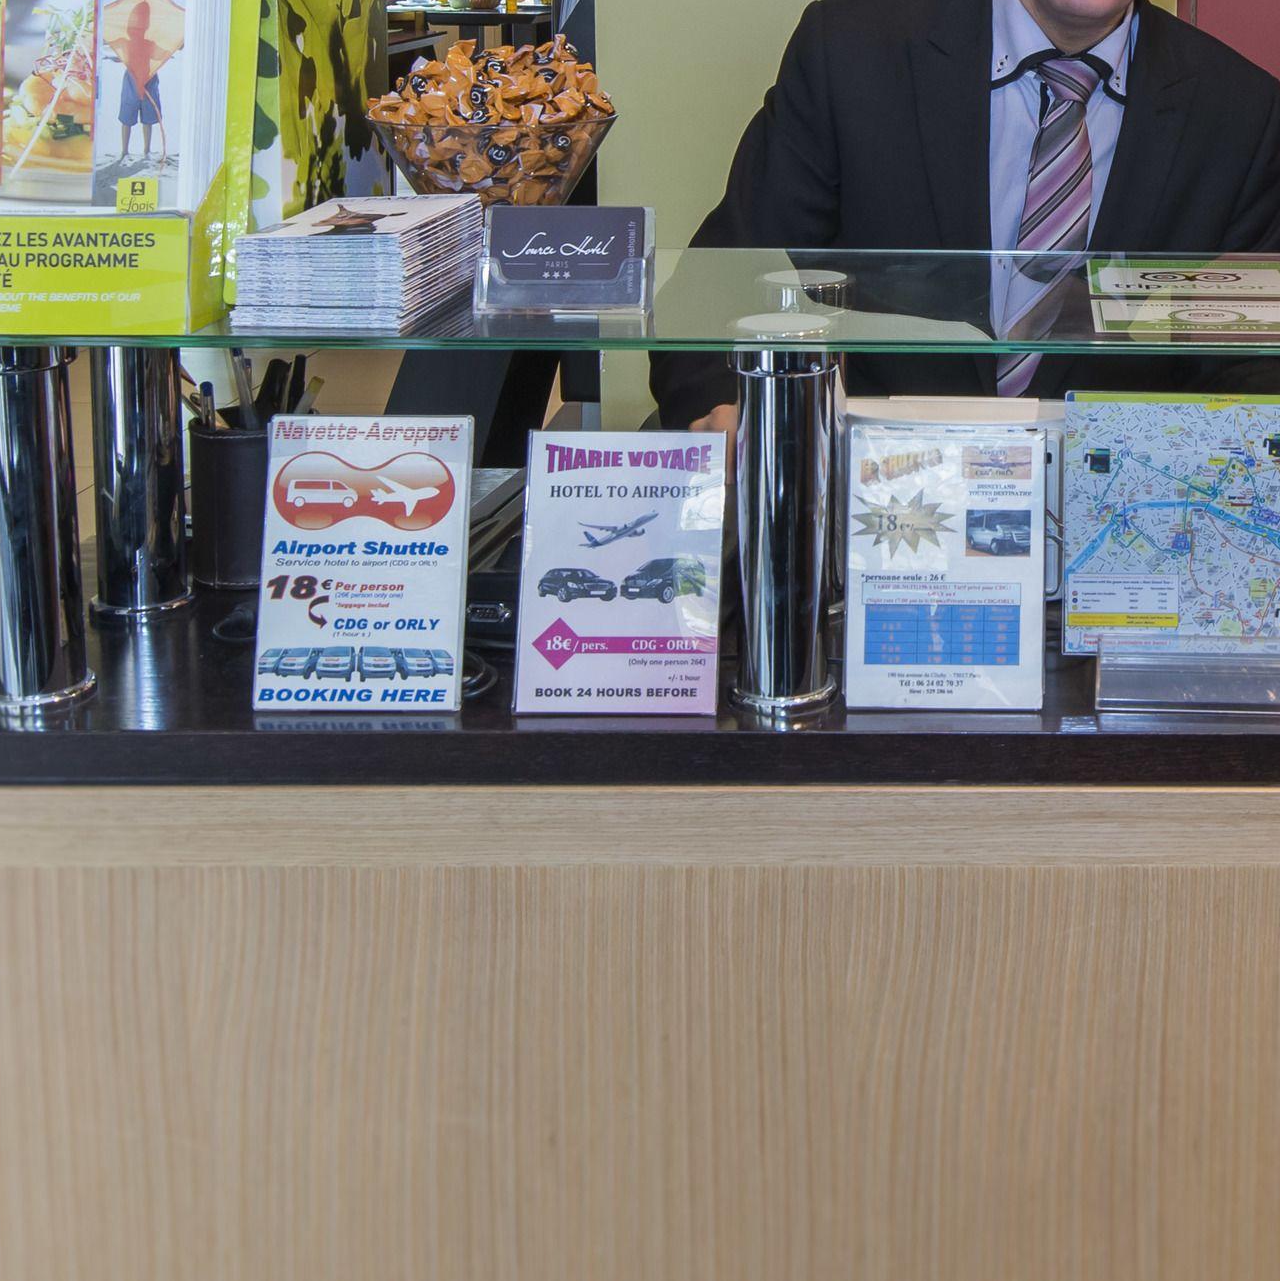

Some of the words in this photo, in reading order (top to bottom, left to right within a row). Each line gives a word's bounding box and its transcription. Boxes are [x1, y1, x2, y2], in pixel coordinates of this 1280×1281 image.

[16, 232, 48, 247] LES
[52, 232, 156, 248] AVANTAGES
[502, 231, 557, 258] Source
[560, 235, 615, 256] Hotel
[25, 253, 139, 268] PROGRAMME
[545, 261, 569, 269] PARIS
[27, 292, 47, 302] THE
[49, 292, 99, 303] BENEFITS
[100, 293, 116, 302] OF
[117, 293, 141, 303] OUR
[545, 443, 624, 474] THARIE
[627, 444, 713, 475] VOYAGE
[550, 485, 603, 498] HOTEL
[606, 485, 629, 499] TO
[631, 485, 704, 499] AIRPORT
[876, 513, 898, 532] 18
[272, 540, 357, 558] Airport
[361, 540, 450, 556] Shuttle
[275, 558, 321, 567] Service
[324, 558, 350, 567] hotel
[351, 558, 361, 567] to
[362, 559, 389, 569] airport
[902, 573, 923, 582] seule
[928, 573, 939, 582] 26
[266, 575, 319, 601] 18
[321, 579, 334, 591] €
[334, 581, 358, 592] Per
[359, 582, 405, 594] person
[349, 592, 373, 600] person
[333, 618, 369, 630] CDG
[373, 620, 391, 630] or
[395, 619, 441, 631] ORLY
[545, 635, 572, 652] 18€
[581, 641, 609, 653] pers.
[631, 639, 657, 651] CDG
[666, 639, 700, 651] ORLY
[628, 657, 648, 667] (Only
[663, 659, 689, 667] person
[257, 688, 373, 702] BOOKING
[380, 689, 447, 703] HERE
[535, 687, 573, 698] BOOK
[576, 687, 592, 697] 24
[596, 688, 642, 698] HOURS
[646, 688, 698, 698] BEFORE
